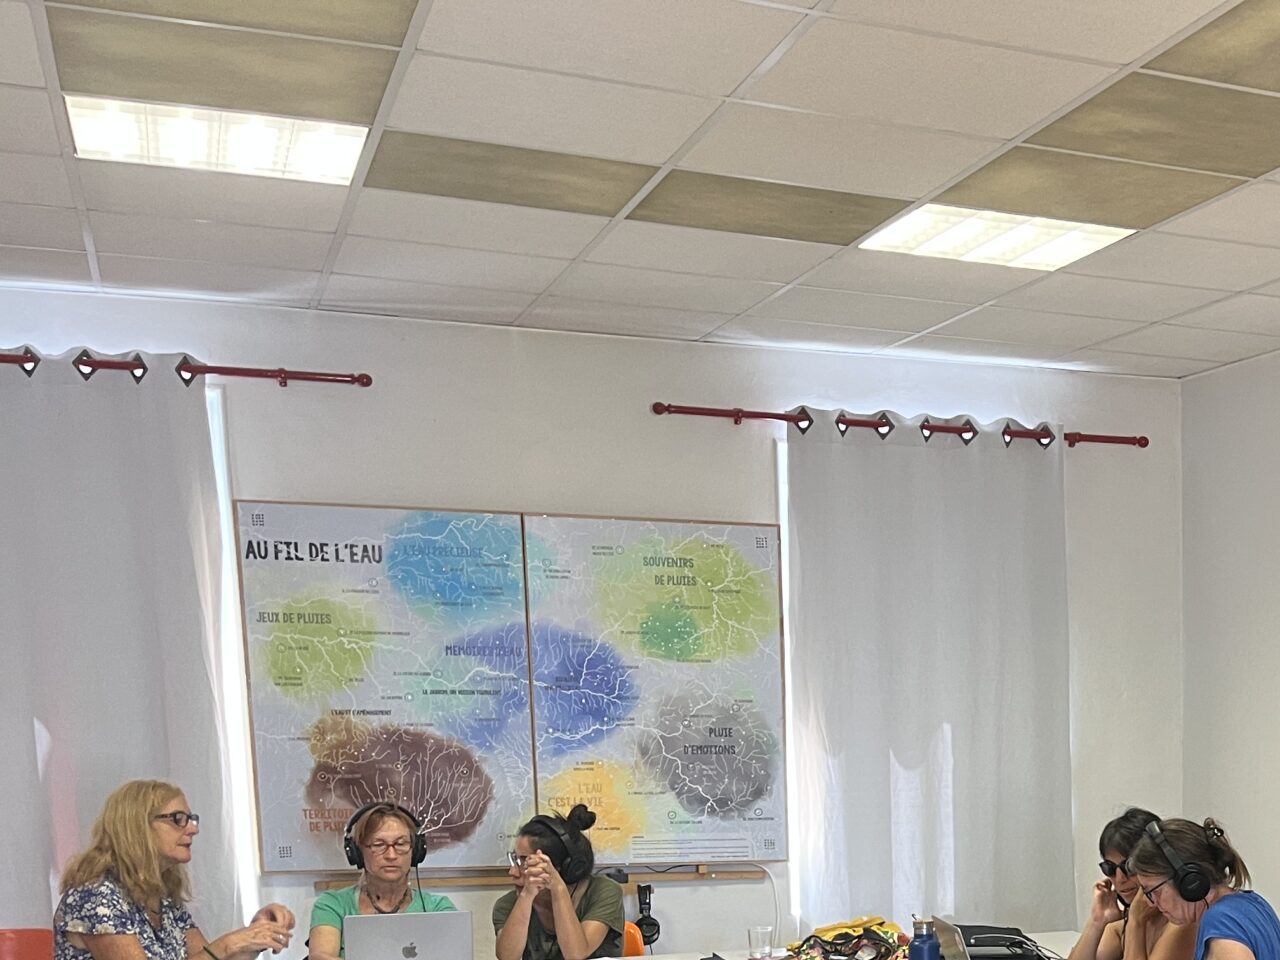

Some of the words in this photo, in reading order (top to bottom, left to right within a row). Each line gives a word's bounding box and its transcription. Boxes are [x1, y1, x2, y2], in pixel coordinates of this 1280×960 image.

[245, 540, 268, 560] AU
[273, 541, 304, 560] FIL
[308, 542, 330, 561] DE
[334, 543, 383, 564] L'EAU
[643, 556, 694, 568] SOUVENIRS
[655, 575, 665, 585] DE
[667, 575, 697, 586] PLUIES
[256, 611, 280, 623] JEUX
[283, 612, 295, 623] DE
[297, 613, 332, 624] PLUIES
[709, 727, 733, 738] PLUIE
[310, 821, 320, 832] DE
